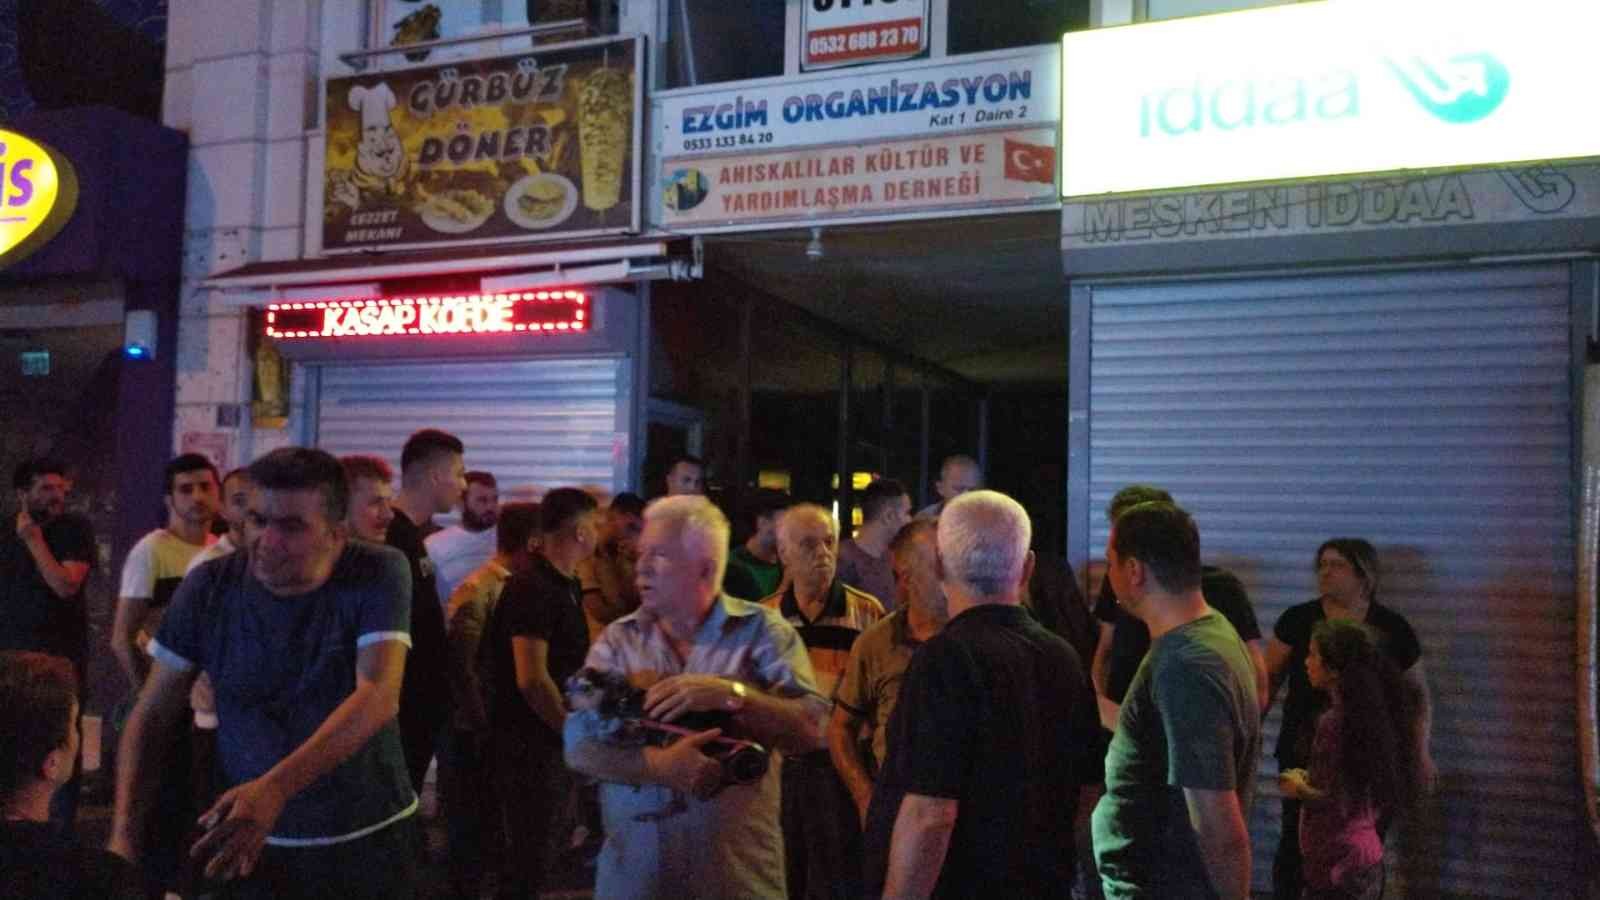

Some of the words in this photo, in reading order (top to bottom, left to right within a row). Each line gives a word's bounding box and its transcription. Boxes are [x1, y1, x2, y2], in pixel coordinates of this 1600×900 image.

[409, 58, 567, 117] GÜRBÜZ
[682, 95, 768, 134] EZGİM
[783, 70, 1032, 124] ORGANİZASYON
[929, 113, 954, 127] Kat
[959, 111, 966, 124] 1
[975, 109, 1013, 123] Daire
[1018, 105, 1028, 118] 2
[418, 122, 550, 166] DÖNER
[719, 155, 856, 185] AHISKALILAR
[865, 144, 950, 173] KÜLTÜR
[959, 143, 986, 165] VE
[721, 184, 874, 213] YARDIMLAŞMA
[883, 170, 981, 201] DERNEĞİ
[1082, 184, 1290, 243] MESKEN
[323, 306, 416, 337] KASAP
